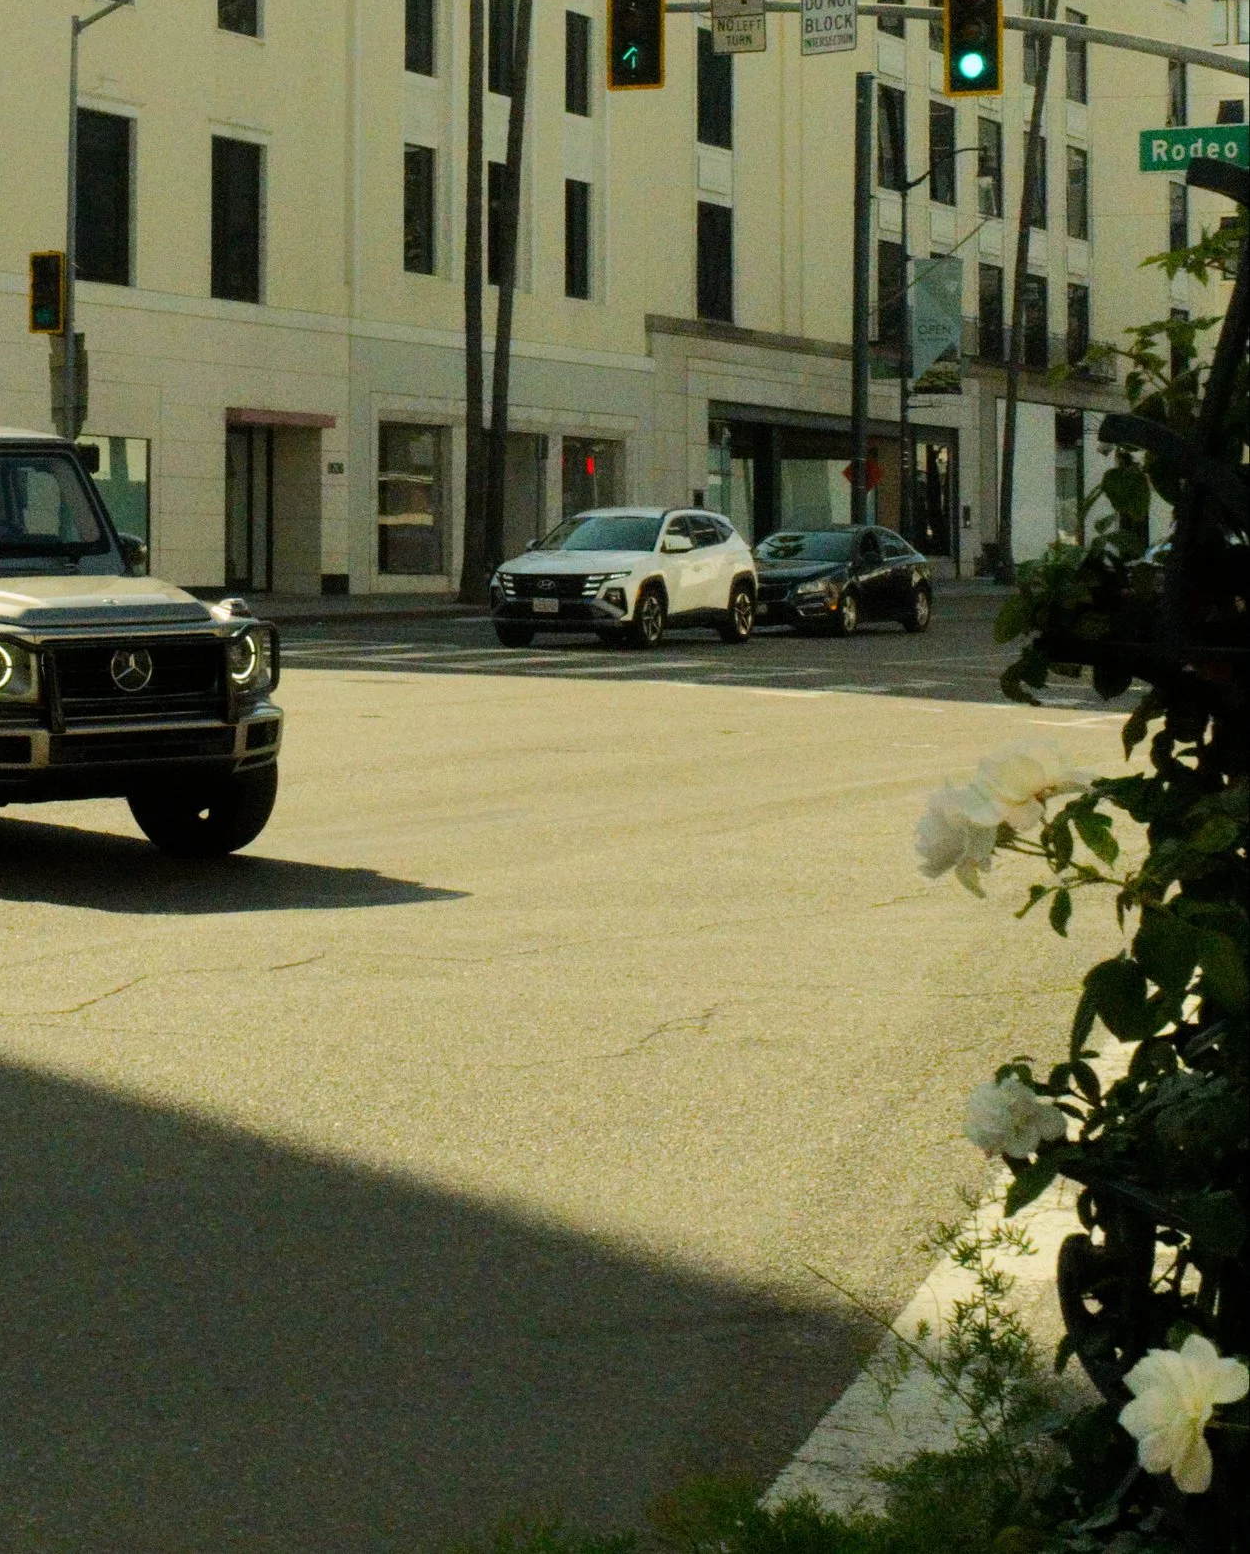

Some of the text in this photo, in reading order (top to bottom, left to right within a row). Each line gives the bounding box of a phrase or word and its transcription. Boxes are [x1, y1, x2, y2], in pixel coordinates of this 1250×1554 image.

[717, 18, 762, 32] NO LEFT
[805, 13, 853, 33] BLOCK
[726, 35, 752, 46] TURN
[1151, 137, 1238, 162] Rodeo
